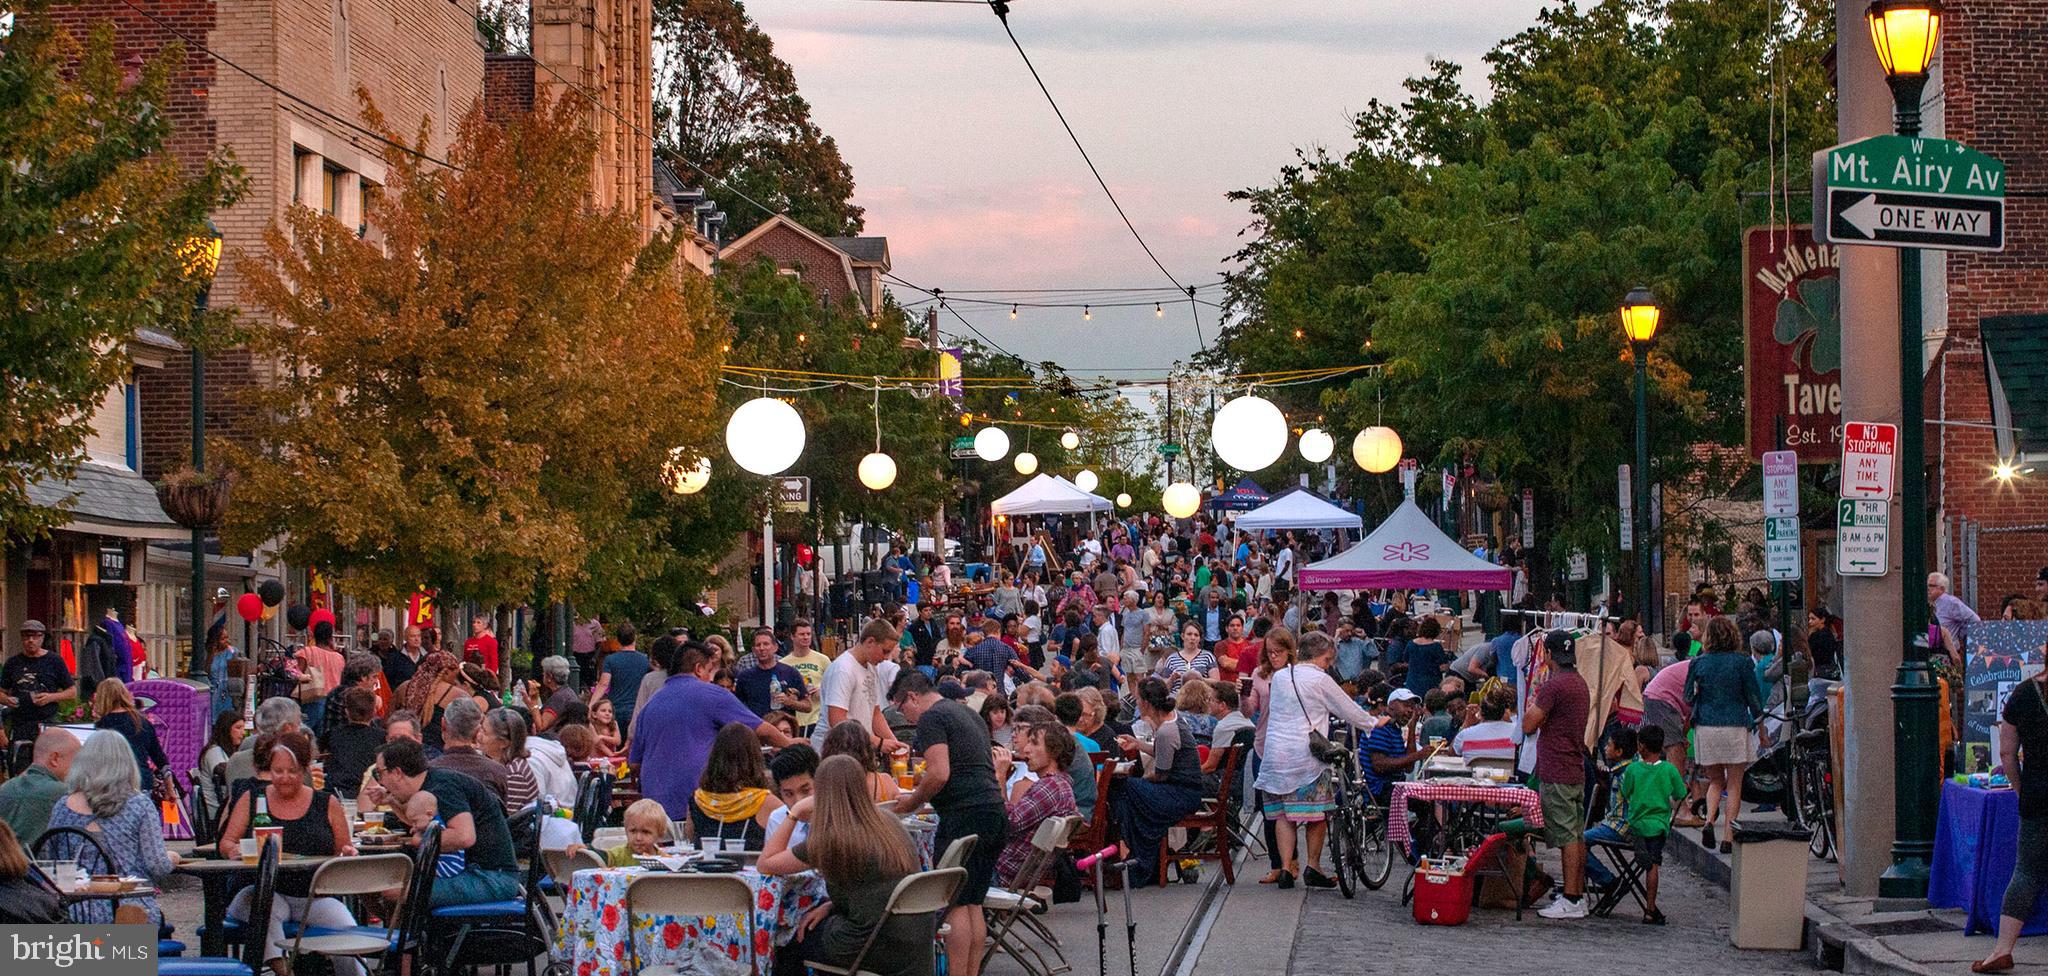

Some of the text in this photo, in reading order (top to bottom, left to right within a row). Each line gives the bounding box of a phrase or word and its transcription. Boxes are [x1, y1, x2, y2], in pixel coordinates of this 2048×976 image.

[1911, 139, 1949, 154] W 1
[1833, 152, 2000, 193] Mt. Airy Av
[1880, 207, 1982, 233] ONE WAY
[1756, 245, 1841, 295] McMena
[1783, 374, 1841, 416] Tave
[1785, 424, 1822, 446] Est.
[1863, 425, 1878, 440] NO
[1847, 439, 1892, 454] STOPPING
[1766, 464, 1794, 474] STOPPING
[1859, 458, 1878, 468] ANY
[1773, 479, 1788, 489] ANY
[1857, 471, 1879, 482] TIME
[1774, 490, 1788, 499] TIME
[1842, 502, 1879, 523] 2 HR
[1855, 514, 1886, 525] PARKING
[1768, 521, 1775, 538] 2
[1776, 529, 1798, 538] PARKING
[1842, 532, 1848, 542] 8
[1850, 532, 1861, 542] AM
[1866, 533, 1871, 542] 6
[1873, 533, 1884, 542] PM
[1970, 668, 2021, 687] Celebrating
[1967, 720, 1976, 729] of
